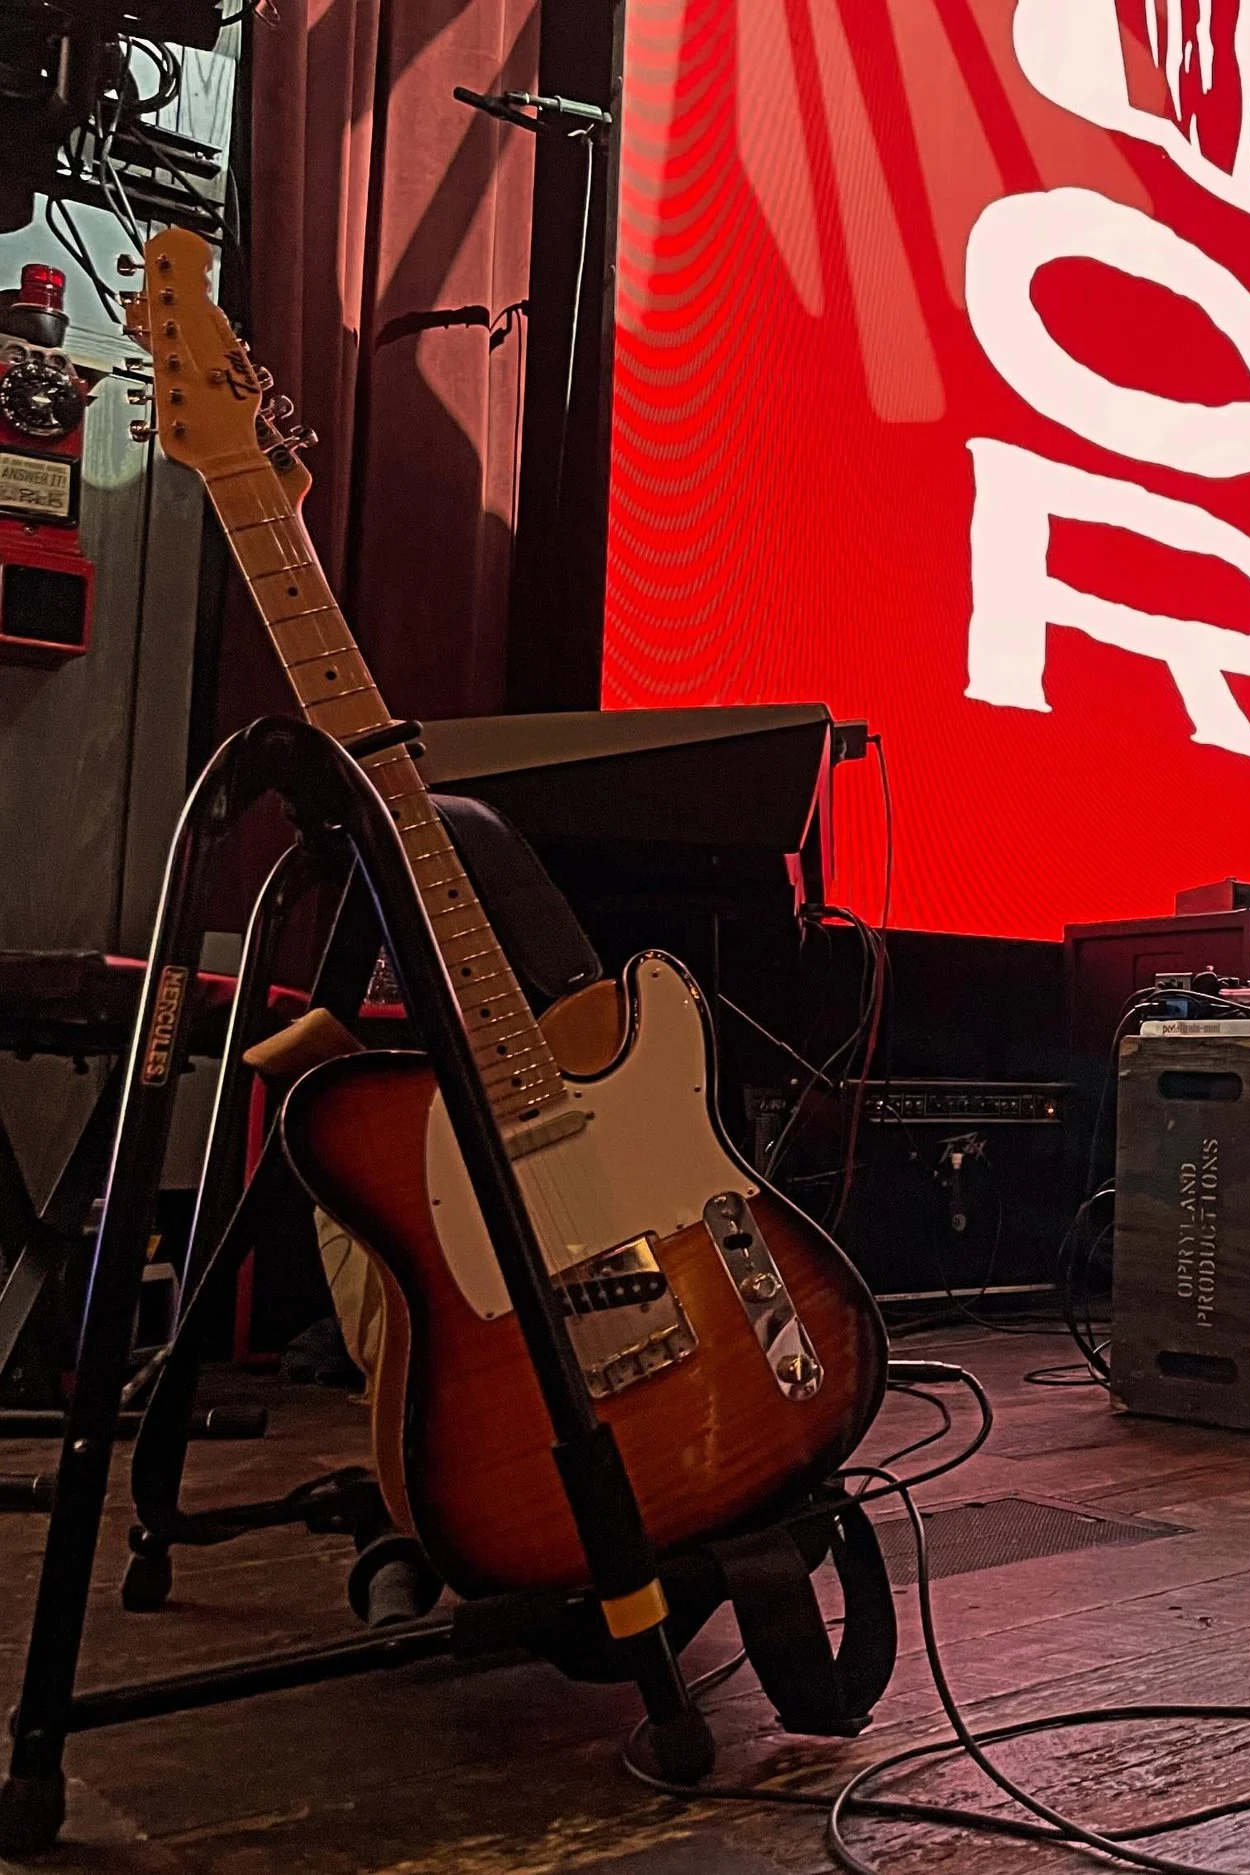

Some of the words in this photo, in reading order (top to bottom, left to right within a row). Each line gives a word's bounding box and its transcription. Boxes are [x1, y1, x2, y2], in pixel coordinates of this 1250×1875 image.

[2, 467, 49, 485] ANSWER
[1178, 1163, 1197, 1297] OPRYLAND
[1197, 1139, 1218, 1327] PRODUCTIONS
